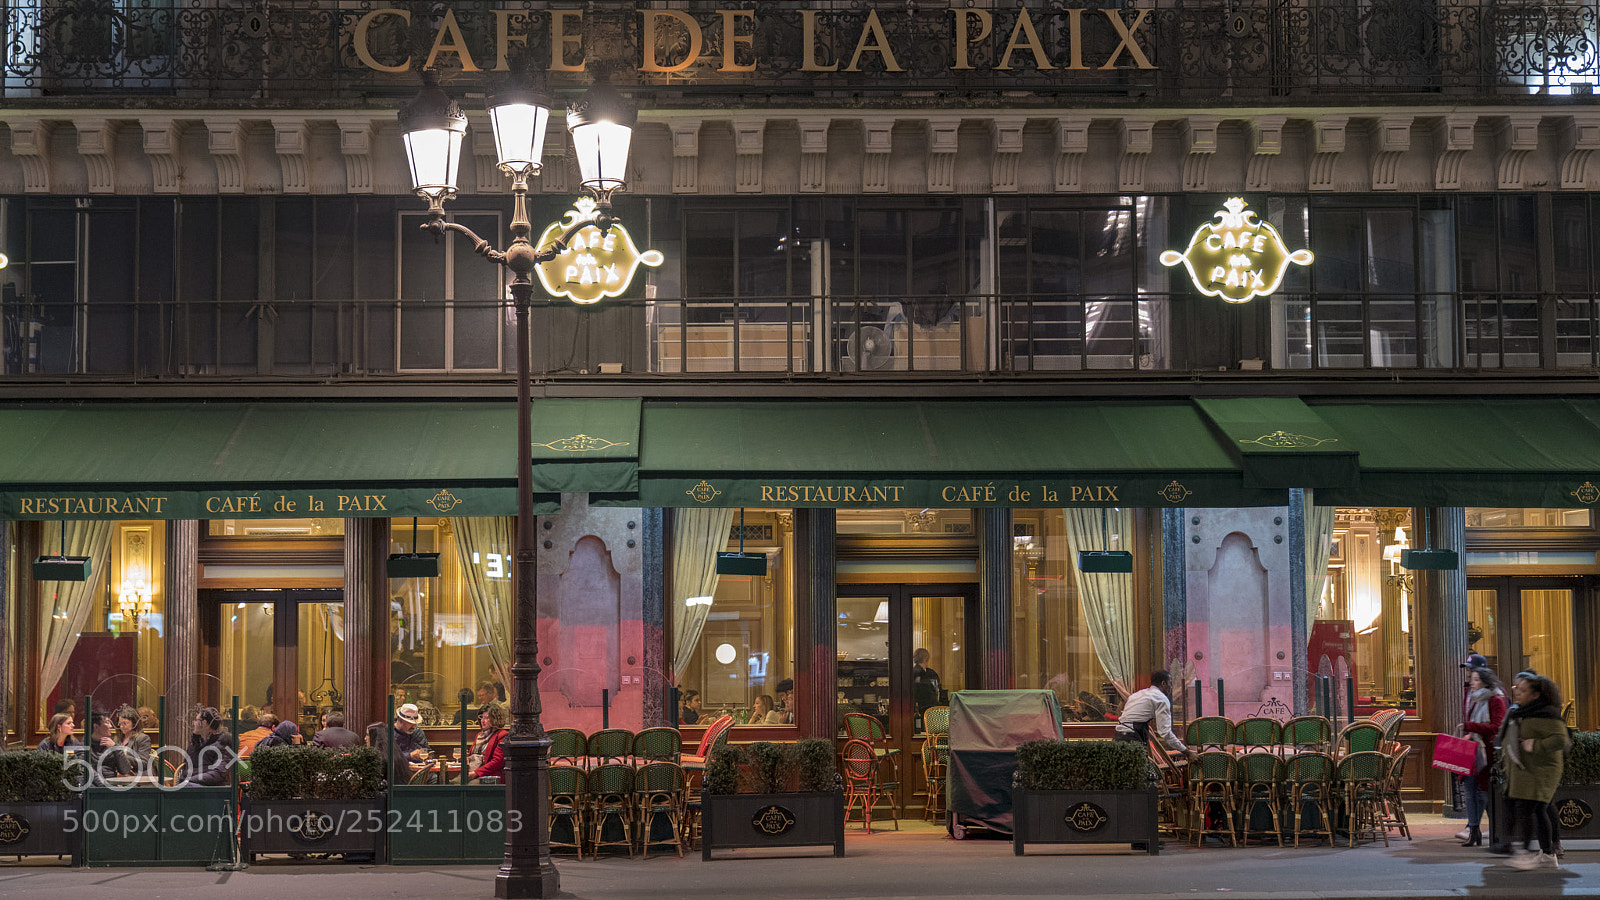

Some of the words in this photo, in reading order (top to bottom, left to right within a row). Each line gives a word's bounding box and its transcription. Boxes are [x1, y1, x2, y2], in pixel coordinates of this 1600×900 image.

[353, 7, 586, 72] CAFE
[637, 9, 757, 73] DE
[796, 8, 907, 72] LA
[948, 6, 1160, 71] PAIX
[561, 231, 617, 254] AFE
[565, 263, 620, 284] PAIX
[1211, 266, 1265, 288] PAIX
[20, 498, 167, 514] RESTAURANT
[206, 492, 262, 513] CAFÉ
[274, 496, 297, 512] de
[309, 496, 325, 512] la
[337, 495, 388, 511] PAIX
[760, 486, 904, 502] RESTAURANT
[942, 482, 997, 502] CAFÉ
[1008, 486, 1031, 502] de
[1042, 486, 1059, 502] la
[1071, 486, 1119, 502] PAIX
